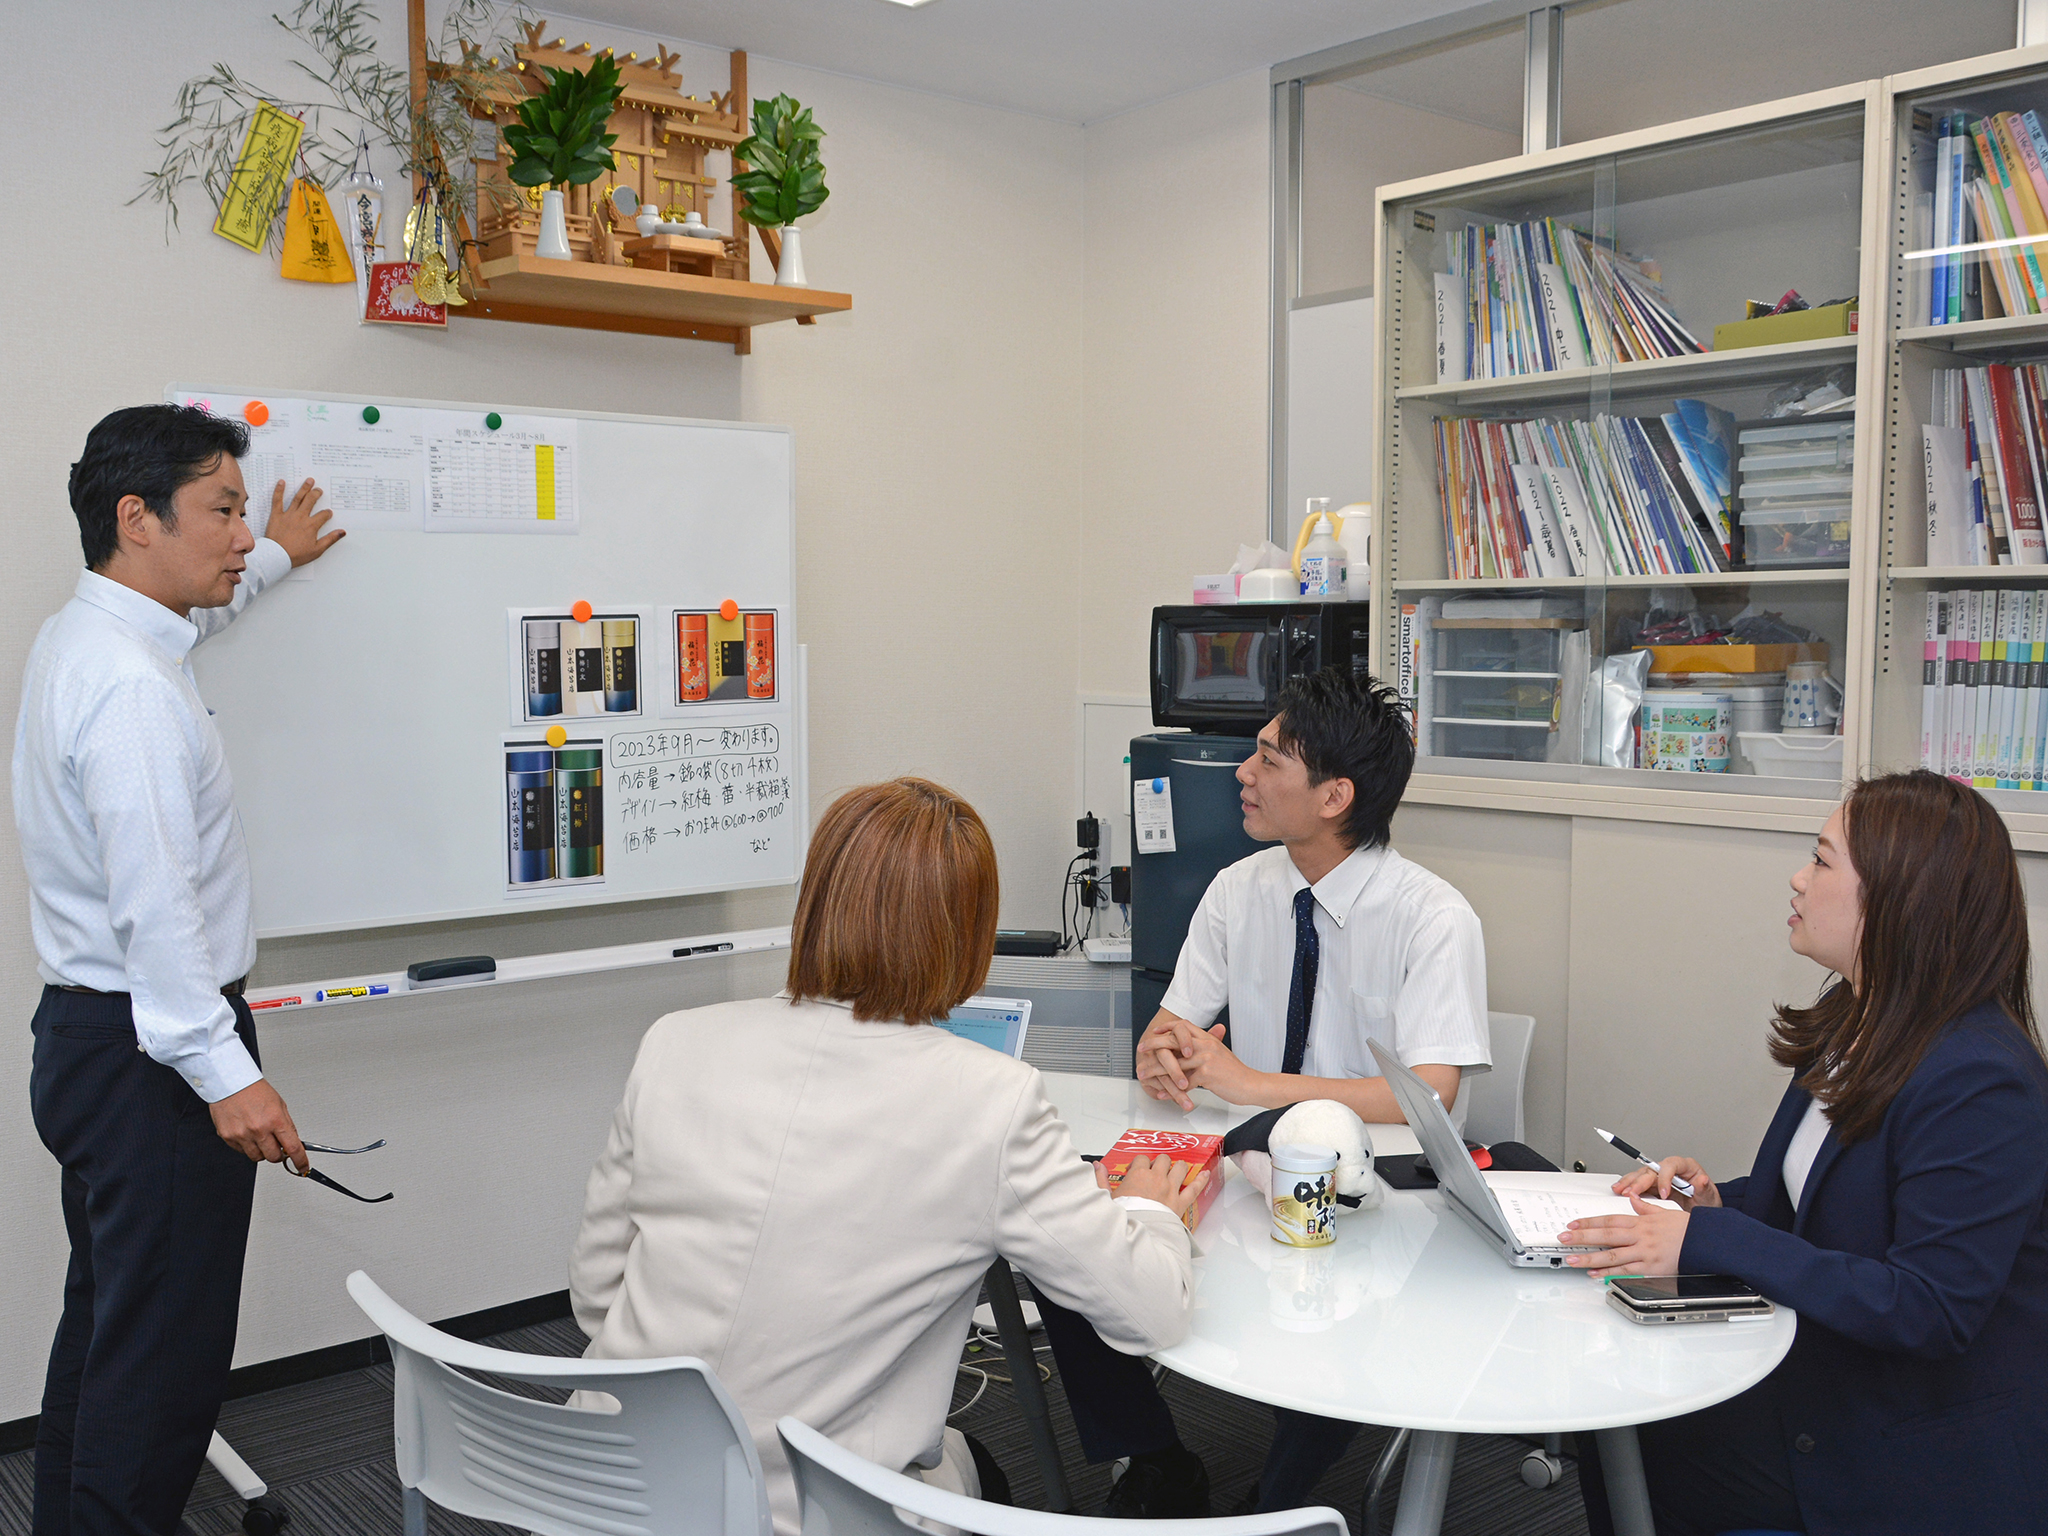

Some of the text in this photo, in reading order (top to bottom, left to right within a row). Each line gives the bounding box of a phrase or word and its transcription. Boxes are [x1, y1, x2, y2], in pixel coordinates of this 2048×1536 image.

[2016, 503, 2037, 519] 1,000
[1401, 616, 1412, 695] smartoffice
[618, 766, 660, 792] 内容量
[621, 798, 657, 823] デザイン
[623, 826, 658, 854] 価格
[750, 838, 771, 853] など
